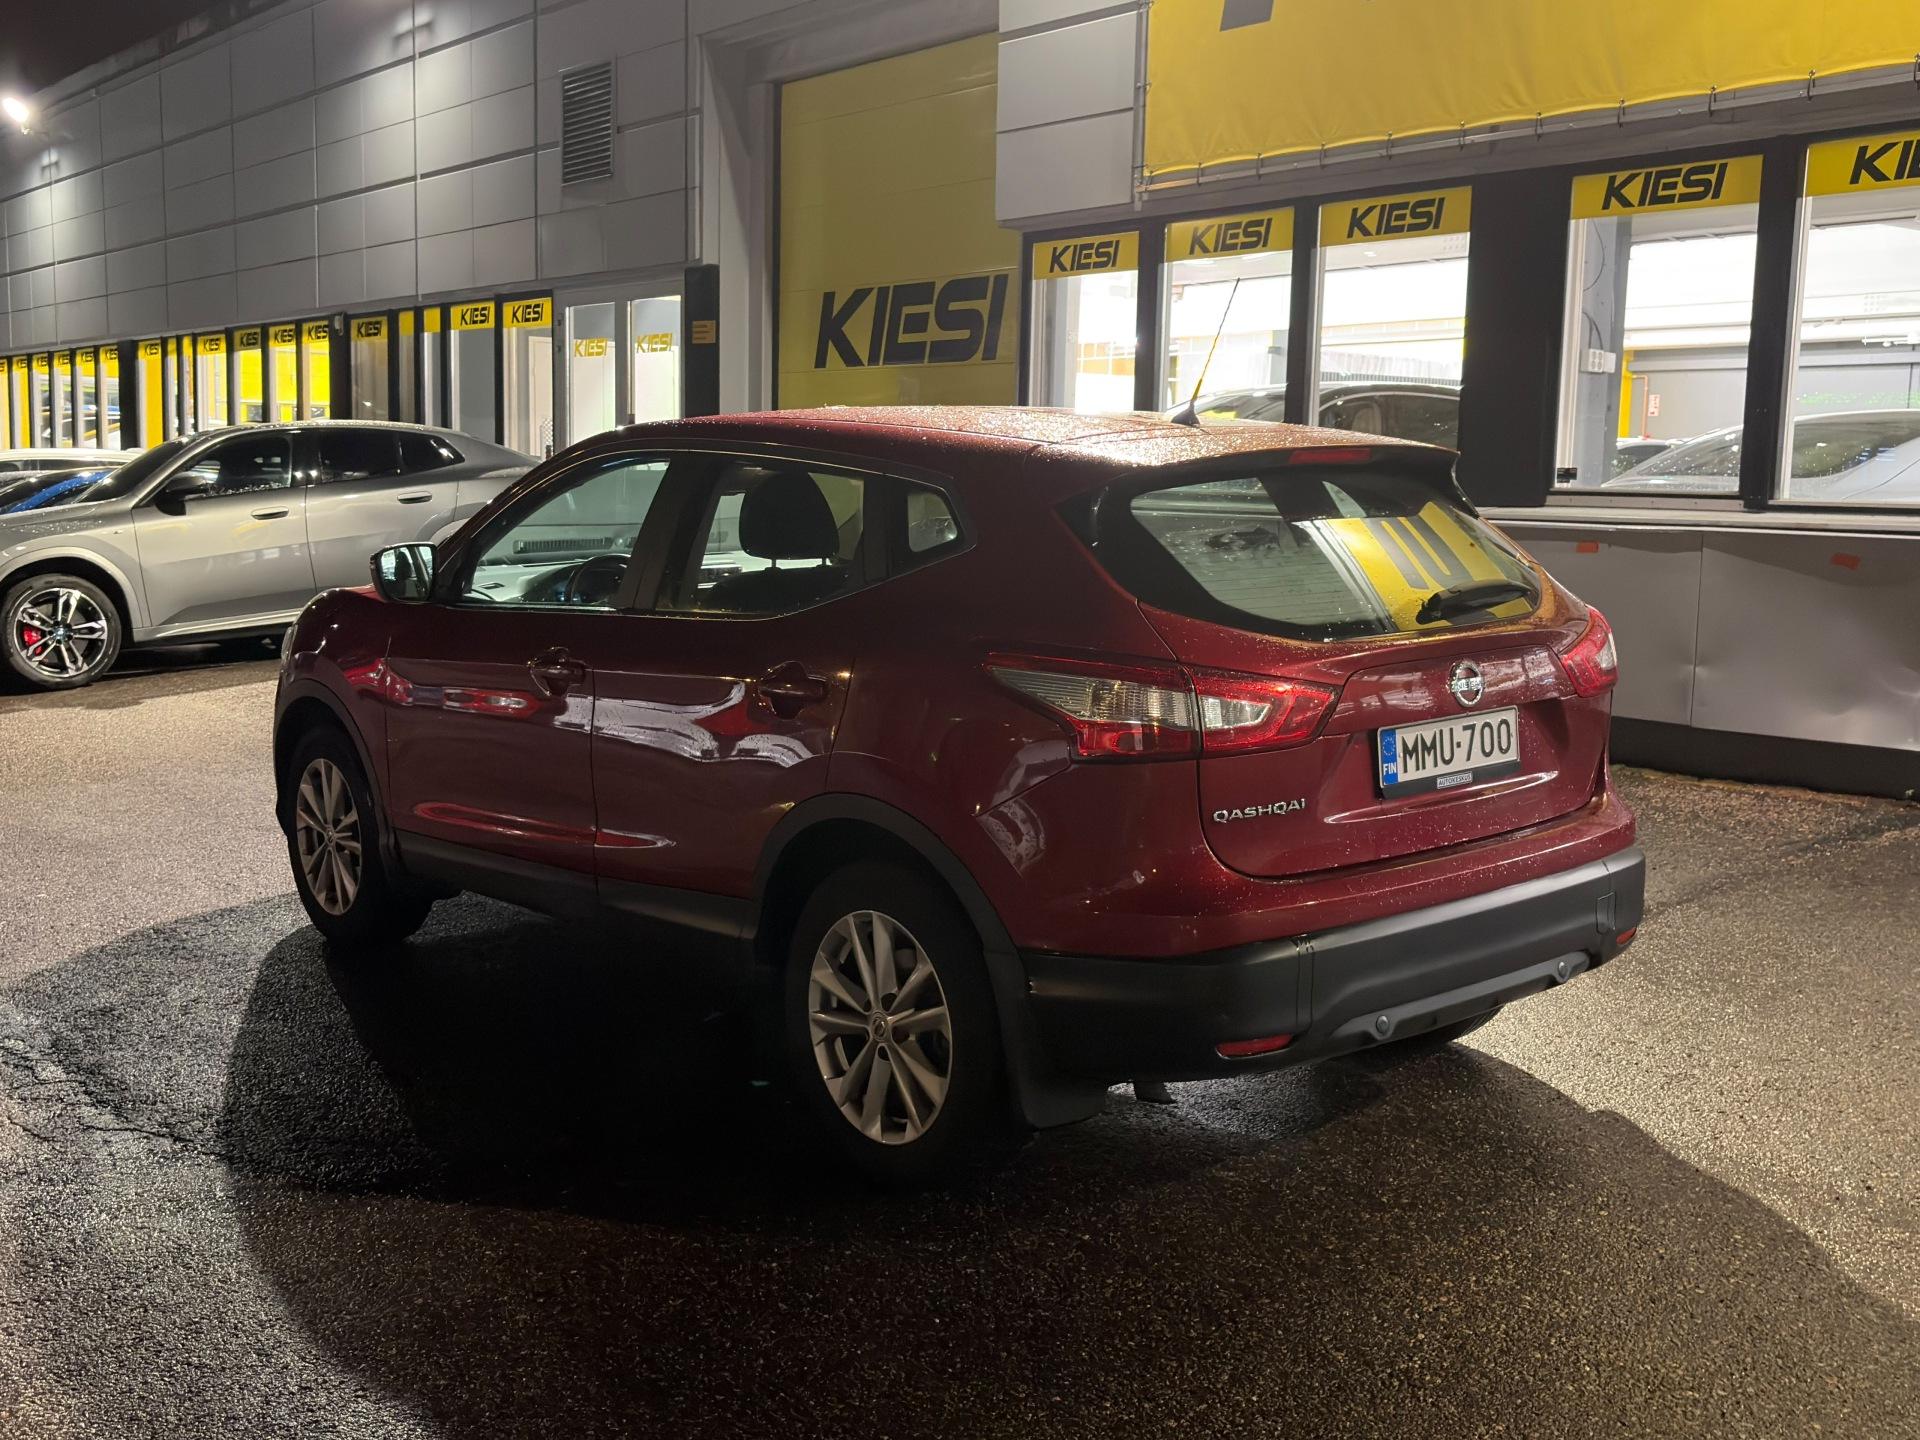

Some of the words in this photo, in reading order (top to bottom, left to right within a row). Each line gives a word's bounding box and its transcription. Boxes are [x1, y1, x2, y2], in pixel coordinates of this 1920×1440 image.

[1602, 162, 1728, 211] KIESI
[1346, 197, 1446, 239] KIESI
[1189, 218, 1273, 256] KIESI
[1049, 240, 1120, 274] KIESI
[460, 306, 491, 325] KIESI
[511, 303, 544, 323] KIESI
[814, 273, 1010, 369] KIESI
[307, 325, 328, 340] KIES
[636, 333, 673, 353] KIESI
[574, 338, 608, 357] KIESI
[1401, 718, 1512, 774] MMU-700
[1383, 762, 1397, 775] FIN
[1213, 798, 1306, 824] QASHQAI
